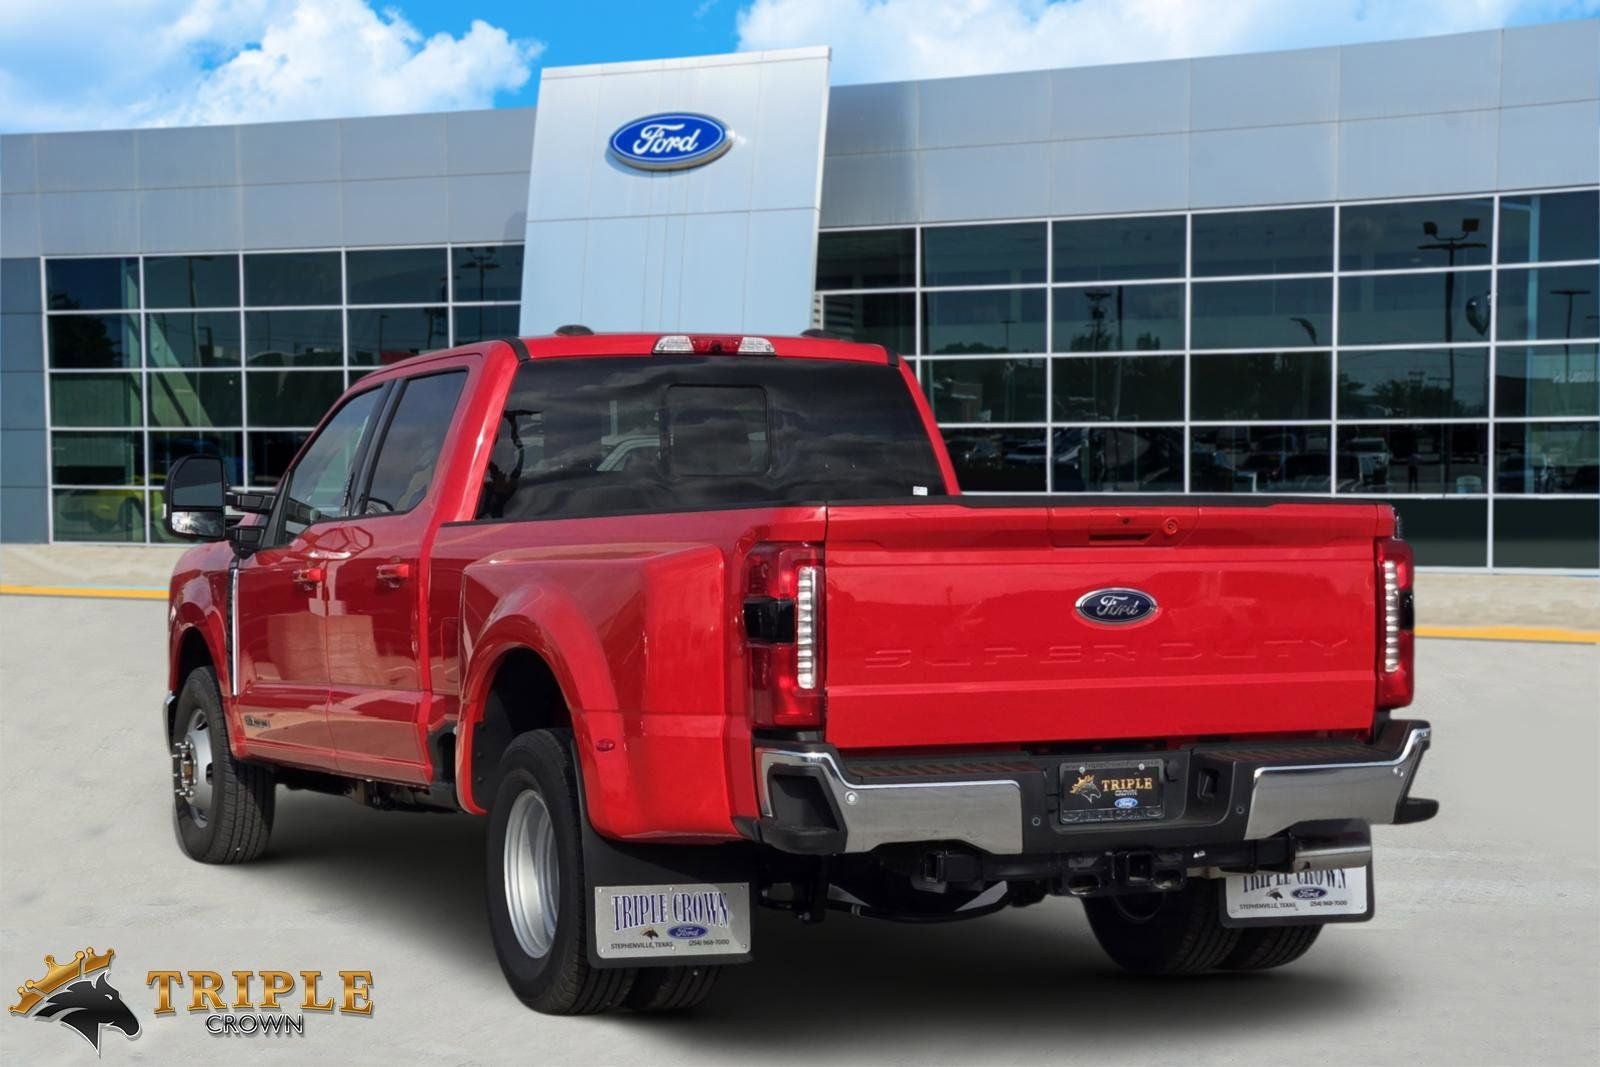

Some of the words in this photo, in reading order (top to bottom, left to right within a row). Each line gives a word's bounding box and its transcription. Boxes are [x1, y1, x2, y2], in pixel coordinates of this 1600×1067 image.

[632, 123, 702, 155] Ford
[1096, 595, 1139, 616] Ford
[865, 645, 1137, 668] SUPER
[1160, 639, 1348, 660] DUTY
[1101, 777, 1153, 792] TRIPLE
[612, 894, 668, 931] TRIPLE
[672, 891, 729, 928] CROWN
[610, 942, 655, 950] STEPHENVILLE,
[655, 941, 673, 949] TEXAS
